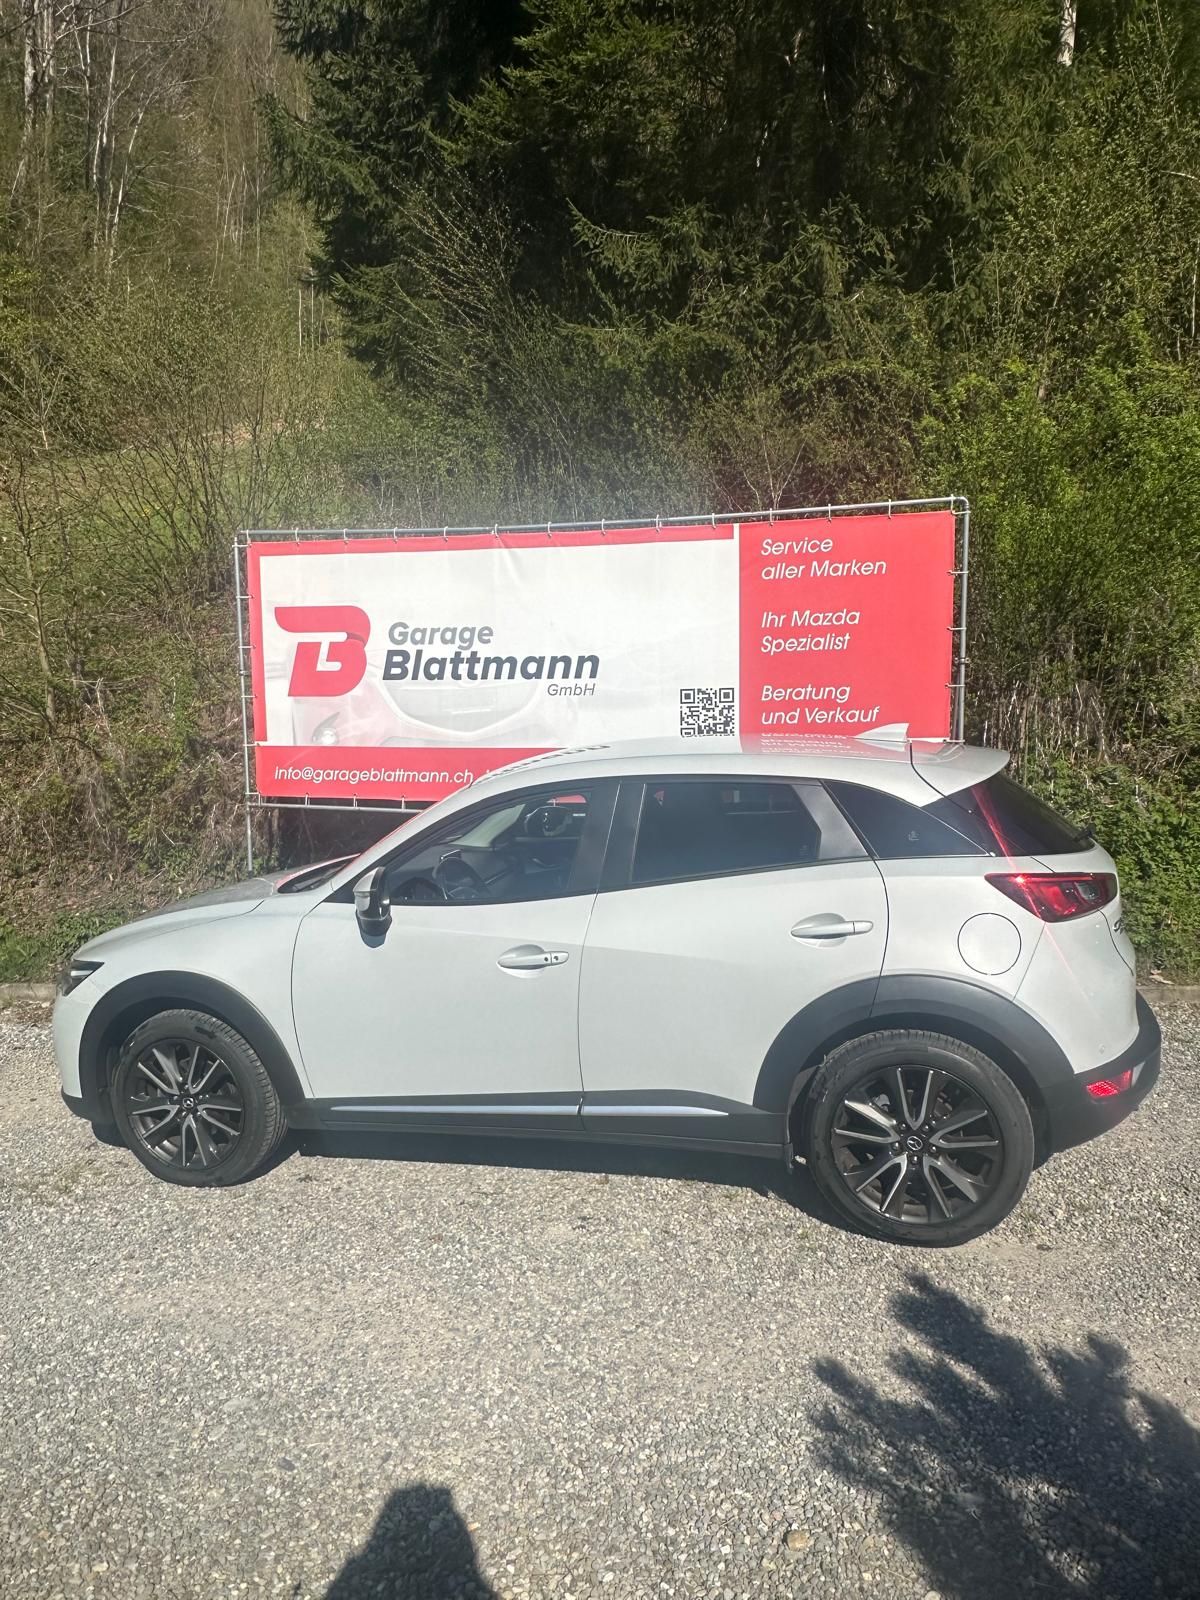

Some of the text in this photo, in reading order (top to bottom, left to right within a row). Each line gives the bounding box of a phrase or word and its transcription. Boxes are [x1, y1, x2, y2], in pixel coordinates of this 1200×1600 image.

[760, 537, 834, 556] Service
[760, 559, 887, 580] aller Marken
[760, 608, 861, 628] Ihr Mazda
[387, 621, 494, 651] Garage
[760, 632, 851, 656] Spezialist
[382, 649, 600, 681] Blattmann
[546, 683, 596, 697] GmbH
[760, 683, 851, 704] Beratung
[760, 705, 880, 725] und Verkauf
[273, 766, 474, 784] info@garageblattmann.ch
